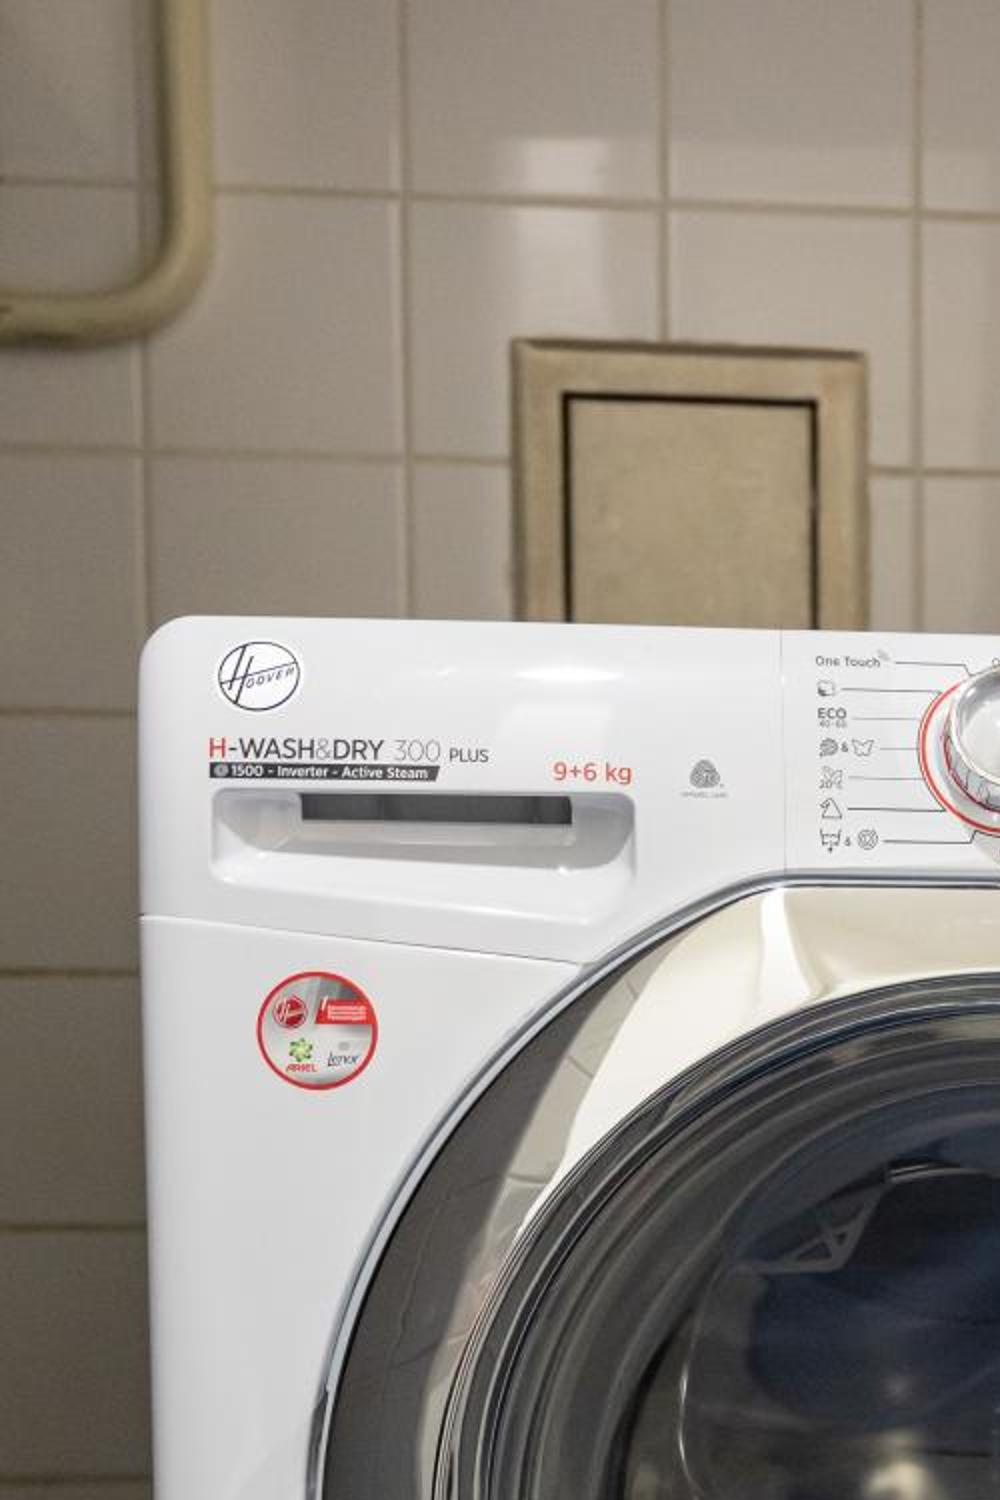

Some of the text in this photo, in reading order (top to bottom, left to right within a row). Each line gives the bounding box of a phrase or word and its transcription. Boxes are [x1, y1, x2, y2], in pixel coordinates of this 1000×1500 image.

[815, 655, 881, 669] One Touch
[817, 707, 847, 719] ECO
[208, 737, 490, 763] H-WASH&DRY 300 PLUS
[231, 765, 263, 777] 1500
[277, 765, 328, 778] Inverter
[341, 766, 383, 779] Active
[386, 767, 429, 779] Steam
[553, 761, 632, 785] 9+6 kg
